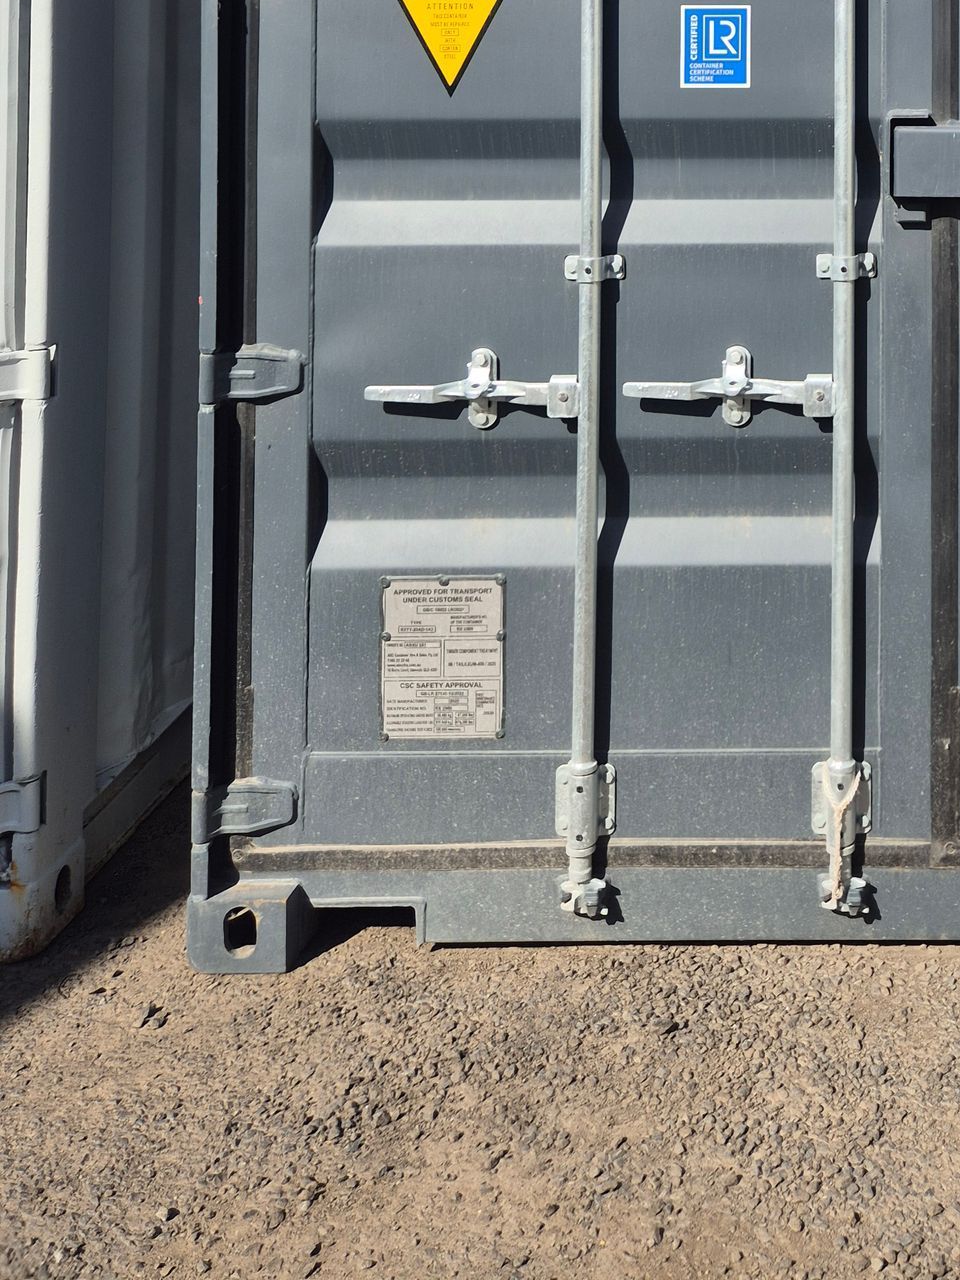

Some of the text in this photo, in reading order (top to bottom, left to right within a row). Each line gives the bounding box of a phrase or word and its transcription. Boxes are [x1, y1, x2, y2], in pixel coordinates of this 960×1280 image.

[426, 2, 474, 10] ATTENTION
[690, 14, 698, 60] CERTIFIED
[709, 20, 737, 55] LR
[393, 588, 432, 596] APPROVED
[450, 587, 493, 595] TRANSPORT
